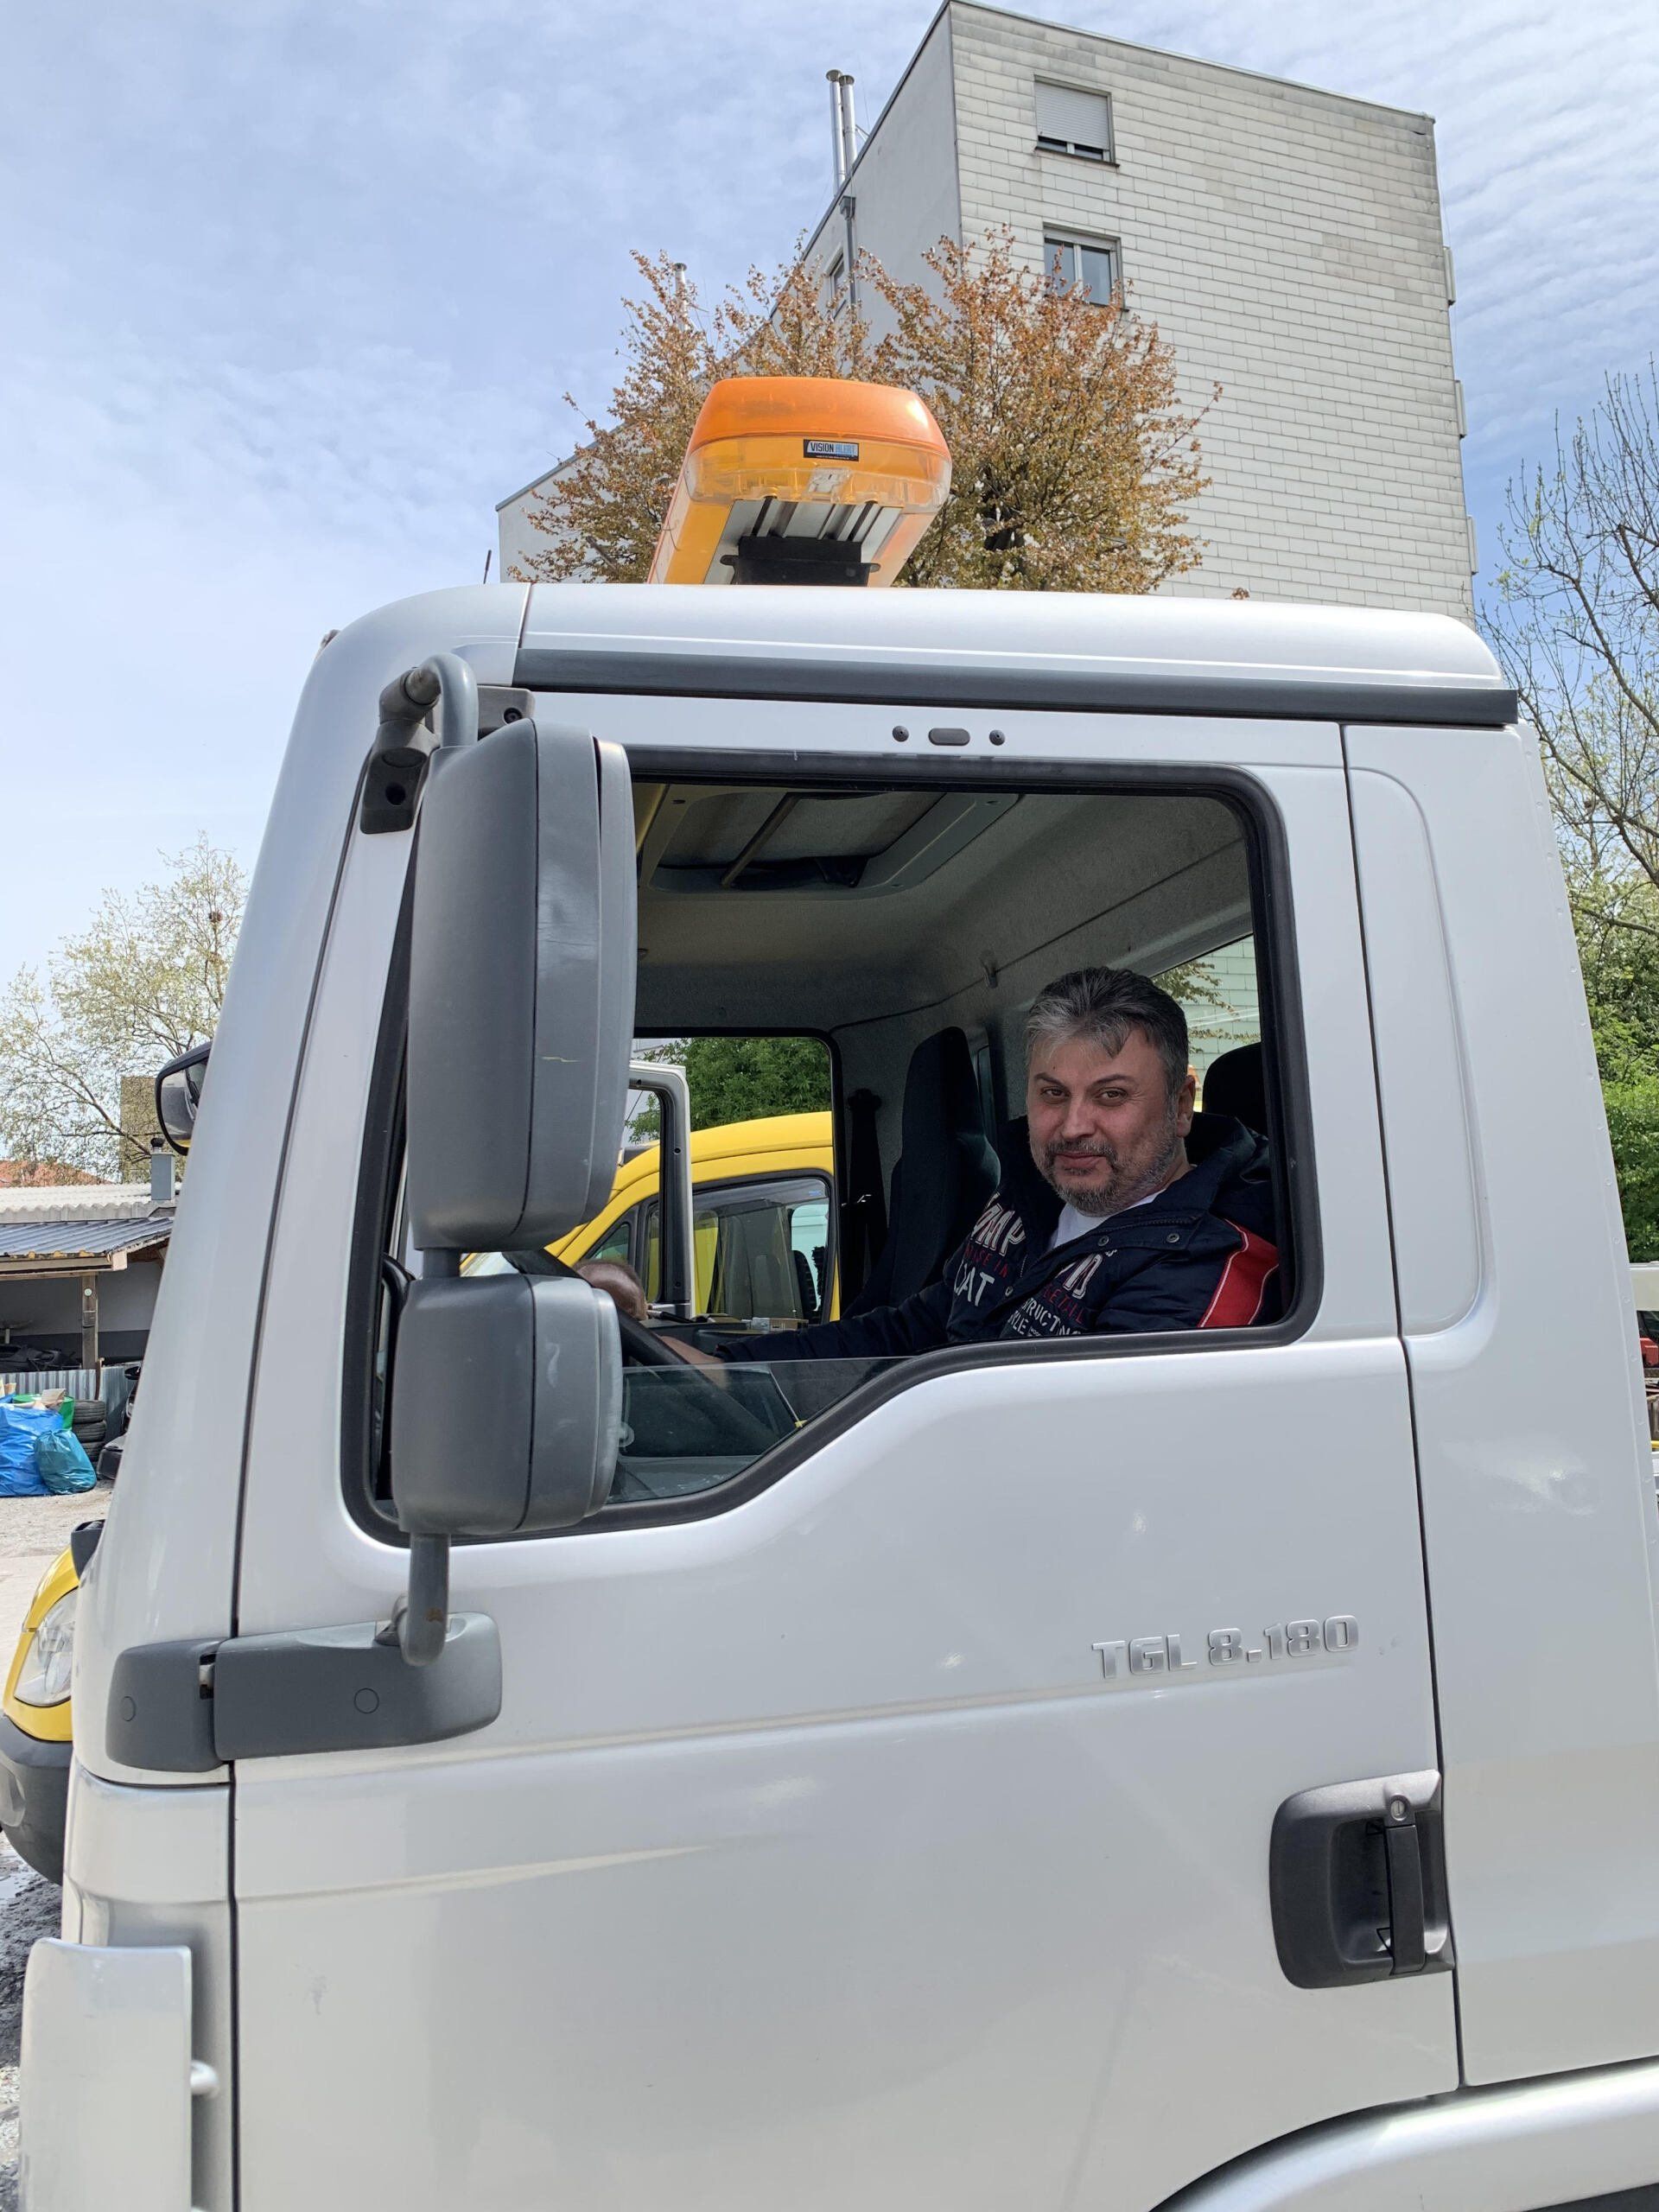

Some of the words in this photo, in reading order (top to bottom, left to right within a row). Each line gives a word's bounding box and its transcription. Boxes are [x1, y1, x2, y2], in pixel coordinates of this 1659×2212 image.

[810, 442, 834, 453] VISION
[1091, 1634, 1198, 1679] TGL
[1208, 1615, 1359, 1666] 8.180
